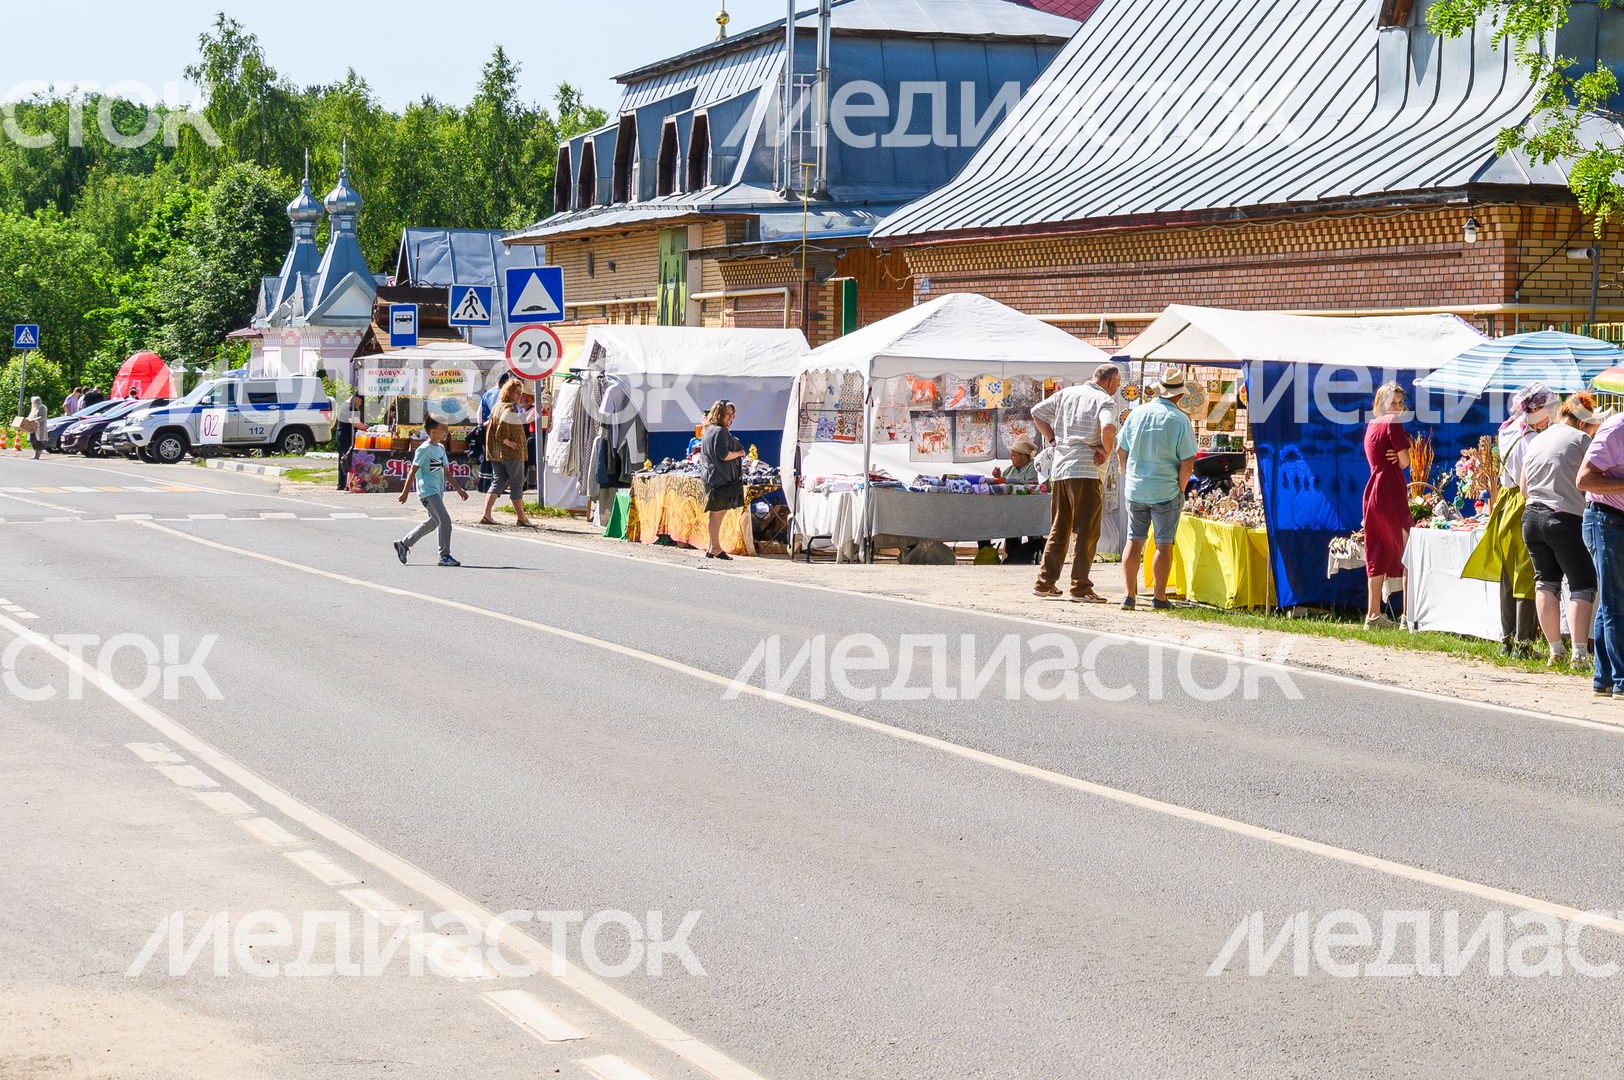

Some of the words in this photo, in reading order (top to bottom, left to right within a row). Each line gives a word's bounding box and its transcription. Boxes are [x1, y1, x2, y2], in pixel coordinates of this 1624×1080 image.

[518, 341, 552, 364] 20
[204, 414, 219, 437] 02
[249, 427, 265, 435] 112
